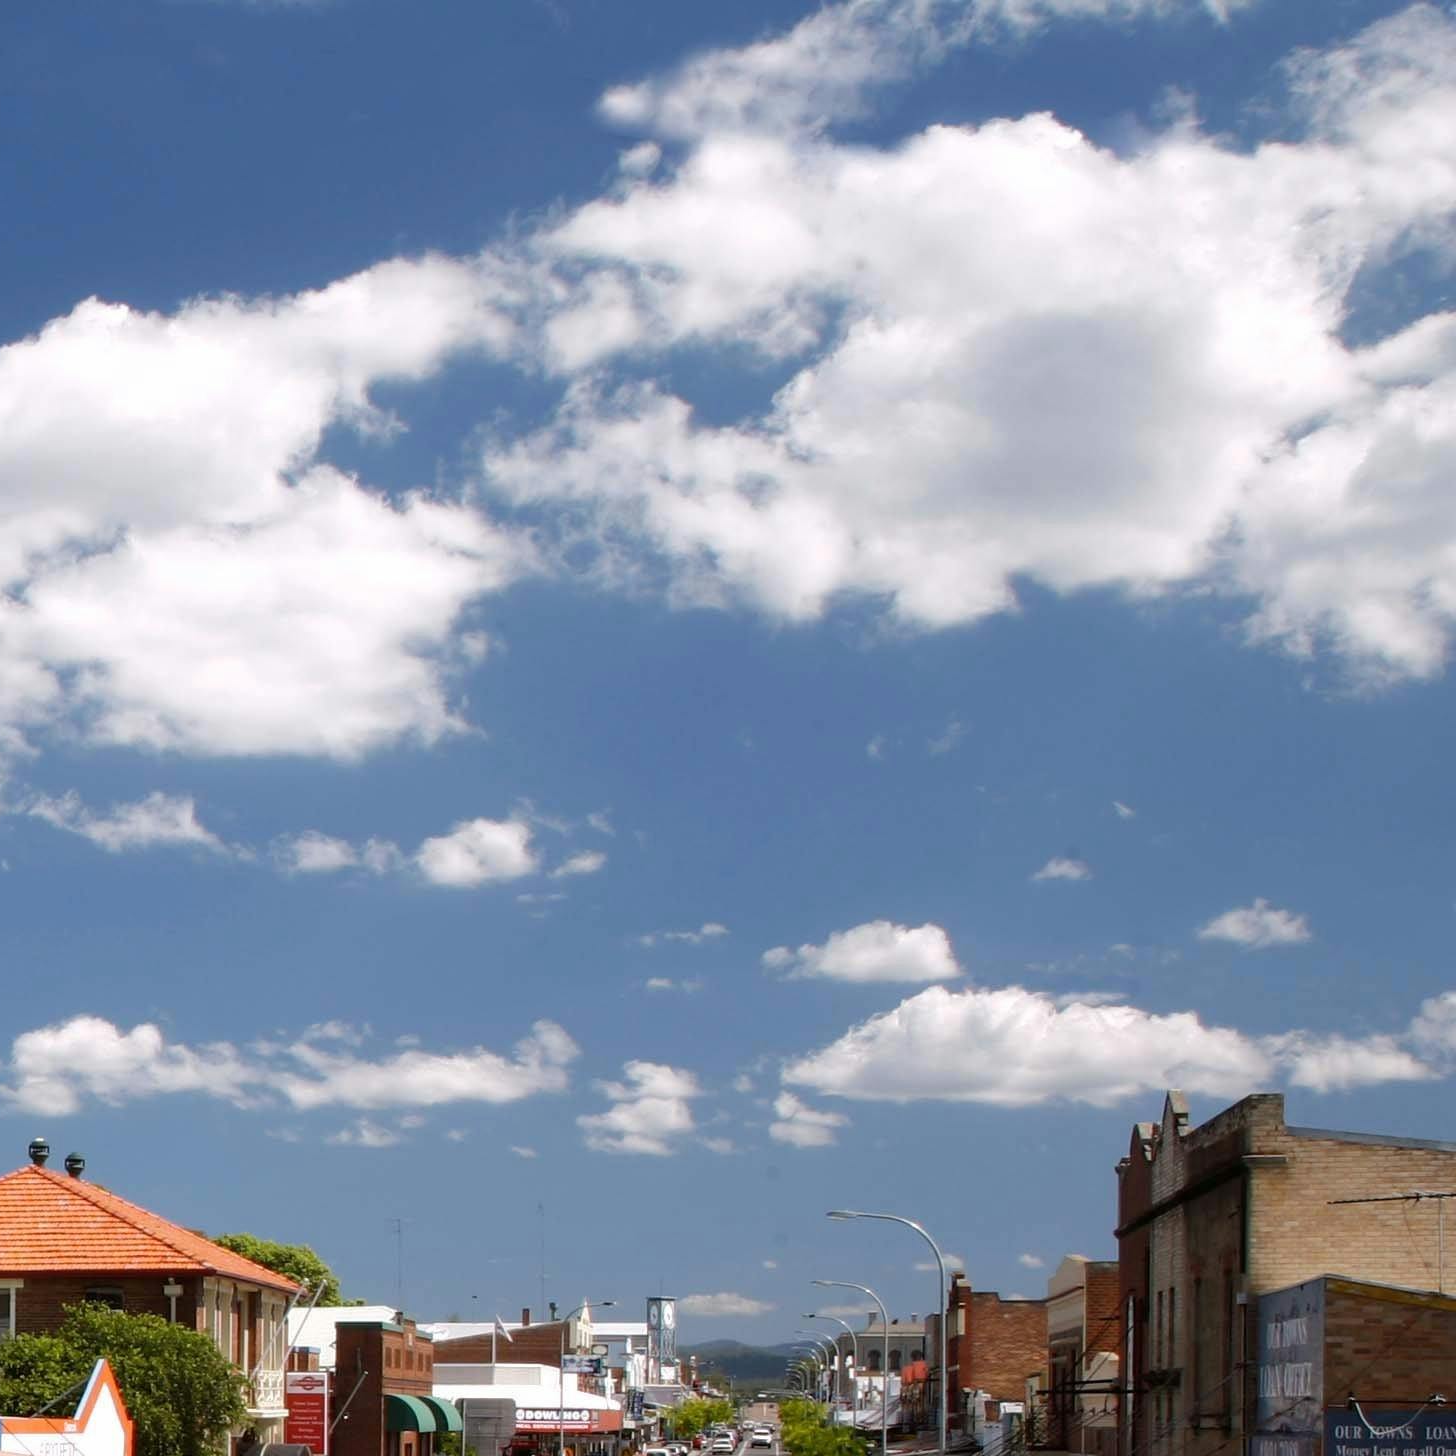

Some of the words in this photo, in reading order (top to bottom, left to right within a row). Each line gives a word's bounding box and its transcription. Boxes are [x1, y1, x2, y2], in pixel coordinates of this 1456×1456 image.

[525, 1410, 581, 1421] DOWLNG
[1334, 1424, 1363, 1440] OUR
[1369, 1426, 1414, 1440] TOWNS
[1373, 1445, 1397, 1456] Lent
[1402, 1448, 1417, 1456] on
